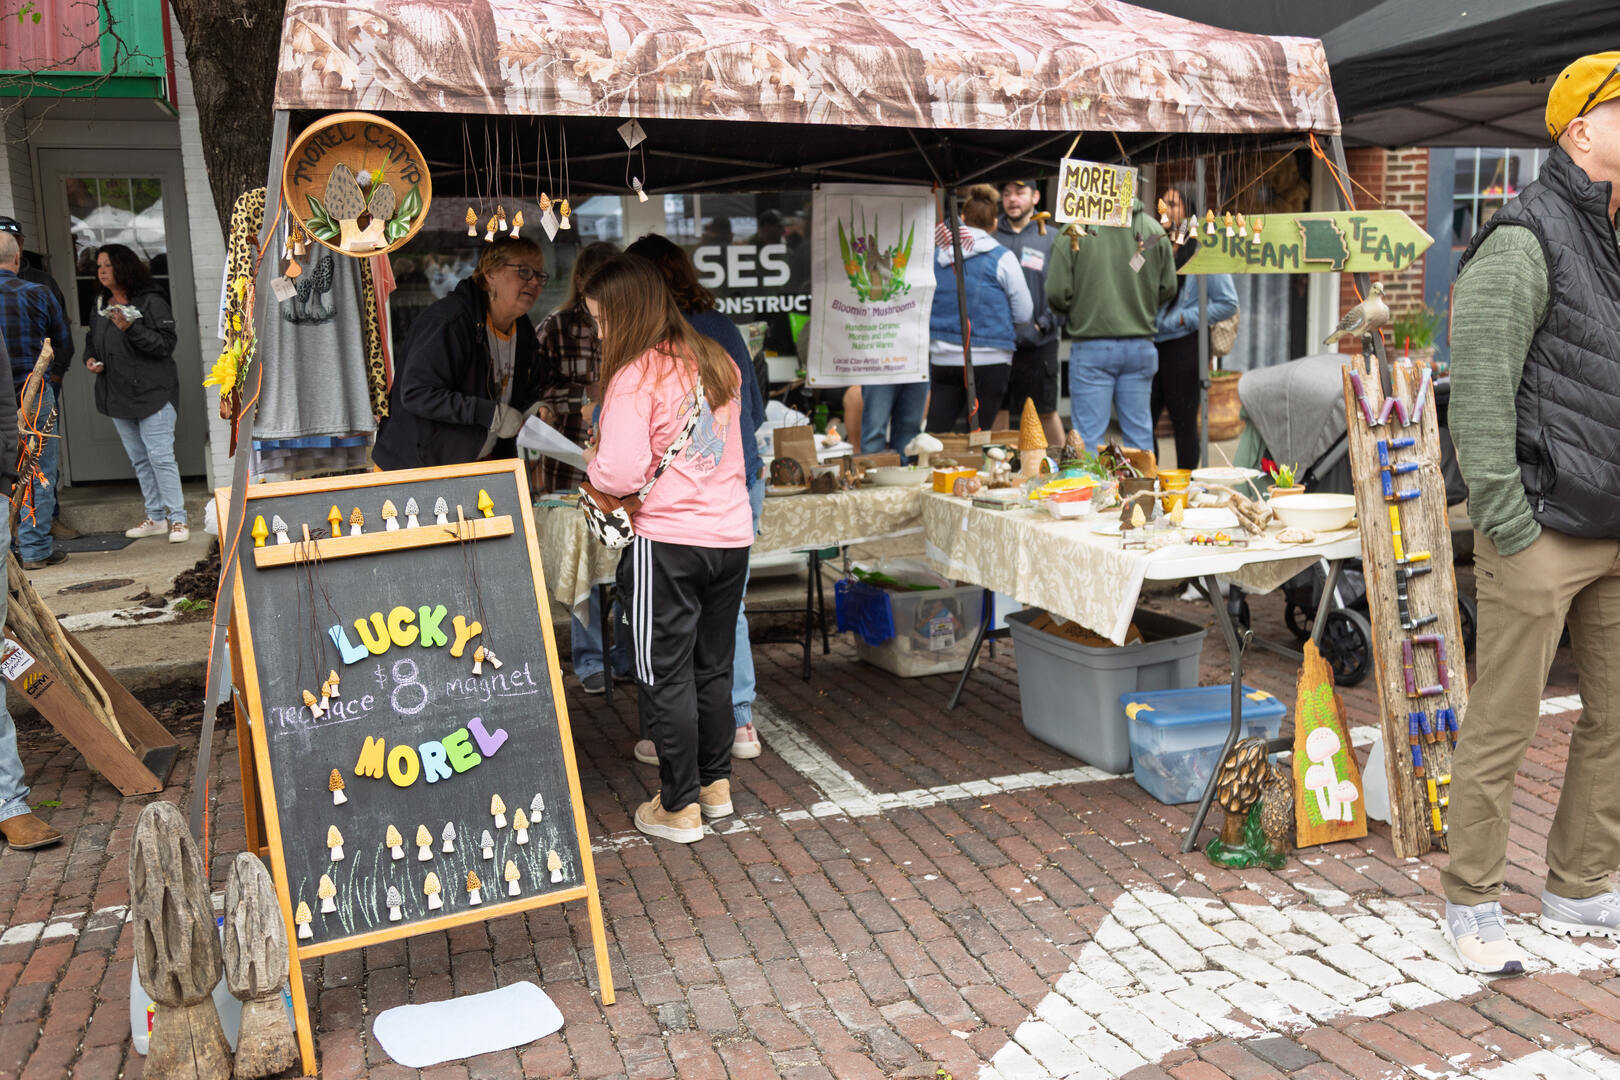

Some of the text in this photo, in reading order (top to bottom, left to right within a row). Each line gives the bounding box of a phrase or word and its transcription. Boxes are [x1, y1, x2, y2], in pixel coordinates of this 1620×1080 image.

[294, 123, 421, 187] MOREL CAMP
[1064, 164, 1118, 198] MOREL
[1063, 191, 1114, 221] CAMP
[1202, 216, 1416, 269] STREAM TEAM
[711, 294, 813, 315] ONSTRUC
[831, 299, 917, 317] Bloomin' Mushrooms
[871, 331, 882, 340] and
[882, 330, 898, 339] other
[832, 356, 849, 365] Local
[327, 604, 483, 666] LUCKY
[27, 674, 49, 696] CFM
[270, 693, 375, 728] necace
[446, 661, 537, 702] magnet
[353, 716, 509, 788] MOREL
